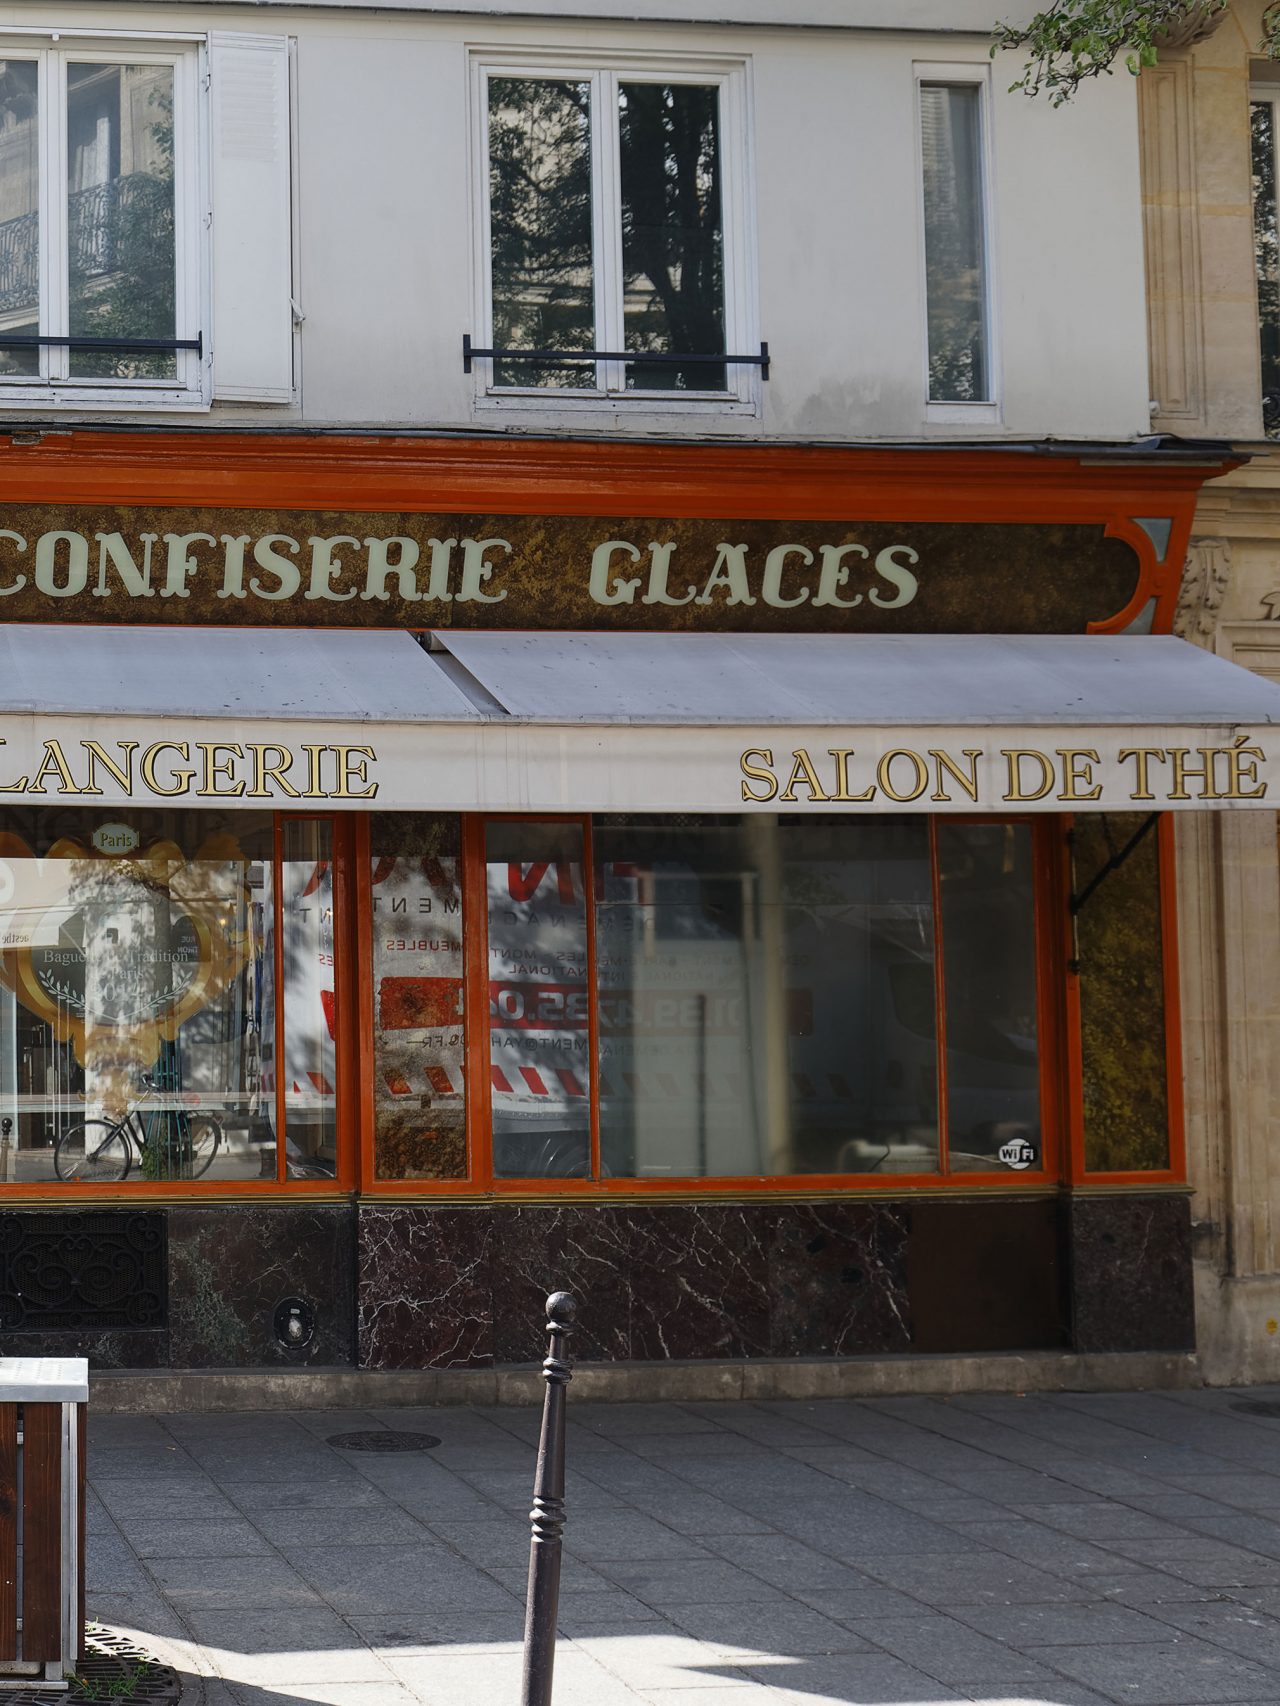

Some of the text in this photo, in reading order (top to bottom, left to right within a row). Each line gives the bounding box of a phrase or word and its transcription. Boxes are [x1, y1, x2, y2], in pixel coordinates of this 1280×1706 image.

[588, 540, 920, 609] GLACES
[740, 735, 1269, 803] SALON DE THÉ
[100, 832, 132, 847] Paris
[129, 950, 189, 964] Tradition
[112, 967, 145, 979] Paris
